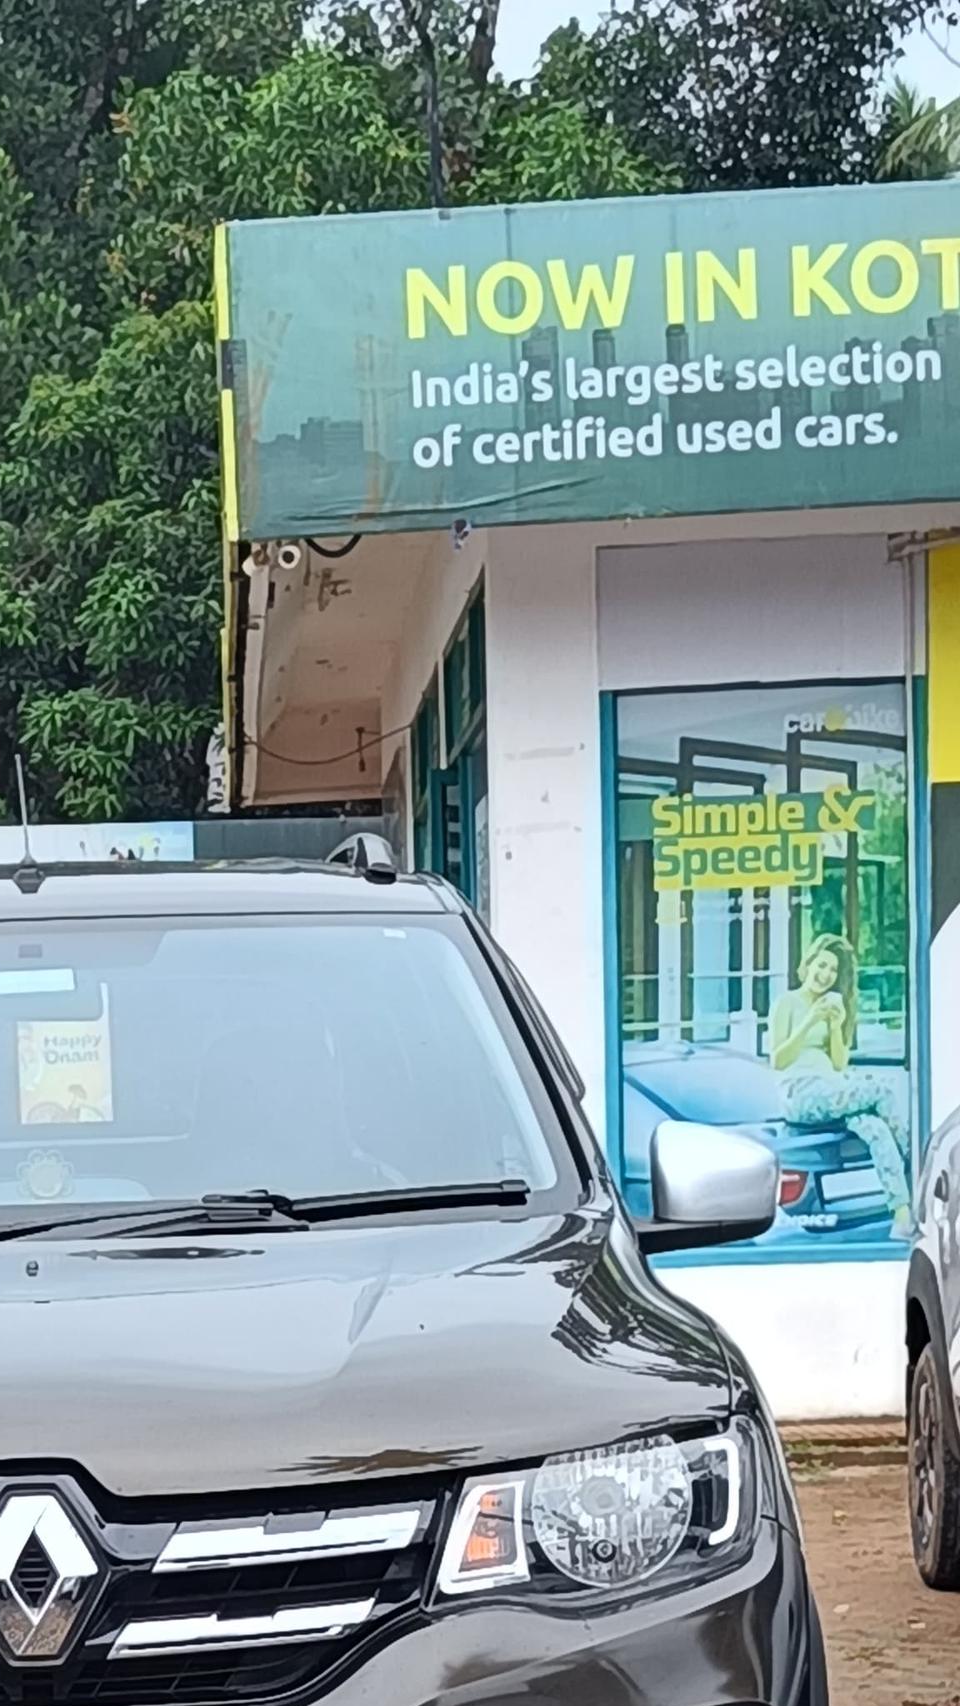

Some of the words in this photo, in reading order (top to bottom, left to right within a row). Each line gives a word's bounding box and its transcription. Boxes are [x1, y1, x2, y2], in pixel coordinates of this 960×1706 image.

[406, 254, 635, 339] NOW
[665, 248, 758, 325] IN
[792, 237, 960, 317] KOT
[411, 362, 553, 408] India's
[565, 355, 723, 405] largest
[736, 345, 941, 391] selection
[412, 428, 461, 469] of
[472, 412, 663, 466] certified
[676, 408, 781, 456] used
[795, 410, 899, 447] cars.
[651, 790, 805, 838] Simple
[818, 785, 875, 832] &
[652, 838, 820, 885] Speedy
[44, 1034, 102, 1048] Happy
